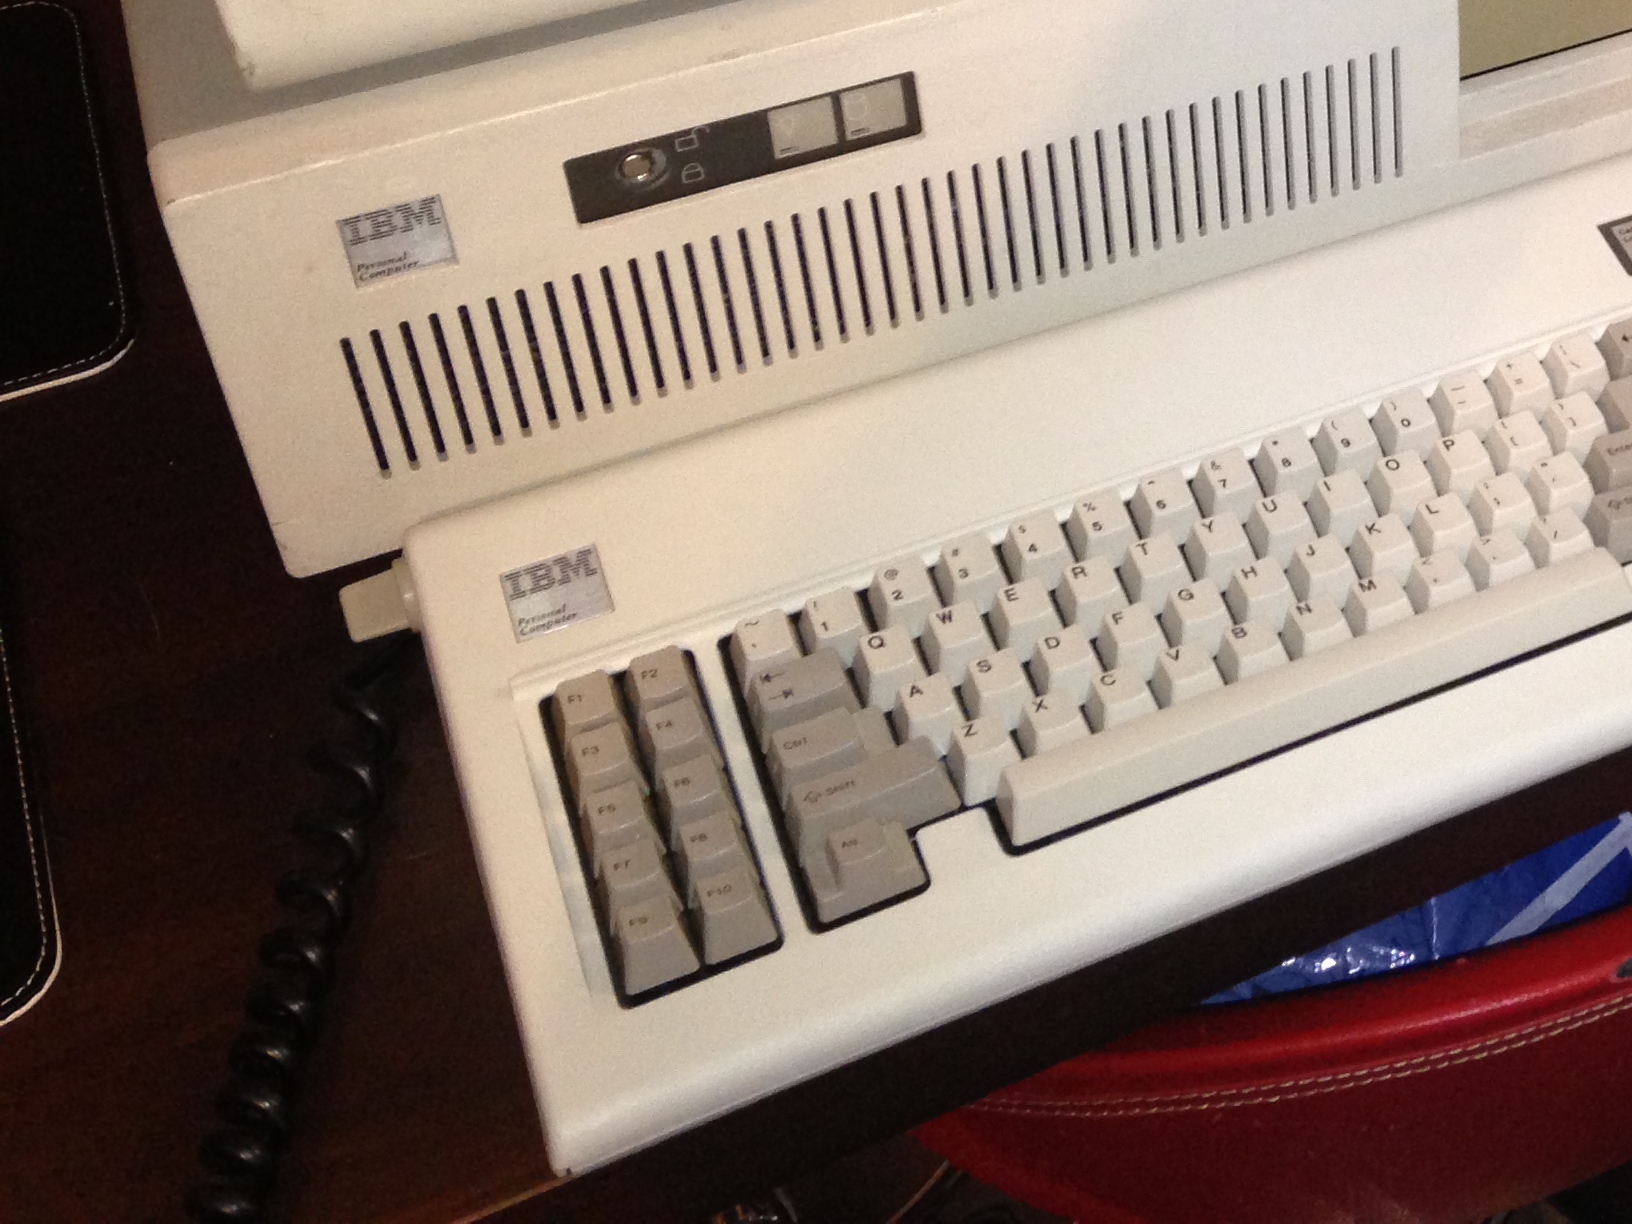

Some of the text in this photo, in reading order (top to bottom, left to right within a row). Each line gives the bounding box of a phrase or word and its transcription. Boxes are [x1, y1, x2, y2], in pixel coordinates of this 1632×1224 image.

[341, 197, 441, 246] IBM
[356, 251, 408, 272] Personal
[359, 261, 420, 281] Computer
[1401, 418, 1411, 427] 0
[1341, 438, 1351, 448] 9
[1442, 438, 1456, 451] P
[1210, 460, 1221, 470] &
[1281, 457, 1292, 467] 8
[1386, 459, 1400, 471] O
[1218, 479, 1228, 488] 7
[1082, 502, 1096, 512] %
[1156, 500, 1167, 509] 6
[1262, 500, 1278, 512] U
[1425, 504, 1439, 514] L
[1092, 521, 1102, 532] 5
[1202, 522, 1217, 533] Y
[1365, 523, 1382, 535] K
[1028, 543, 1038, 554] 4
[1136, 544, 1151, 555] T
[1305, 545, 1316, 557] J
[504, 549, 598, 600] IBM
[884, 568, 899, 580] @
[958, 568, 969, 578] 3
[1072, 567, 1088, 578] R
[1242, 566, 1258, 578] H
[1359, 580, 1377, 592] M
[891, 590, 904, 600] 2
[1004, 588, 1018, 601] E
[1178, 588, 1194, 601] G
[518, 604, 566, 626] Personal
[1296, 604, 1312, 616] N
[936, 611, 954, 624] W
[1112, 612, 1124, 625] F
[520, 612, 578, 636] Computer
[821, 621, 829, 632] 1
[1232, 627, 1247, 638] B
[868, 635, 886, 649] Q
[1045, 637, 1061, 648] D
[1167, 650, 1181, 661] V
[976, 660, 992, 673] S
[641, 668, 658, 680] F2
[1101, 674, 1116, 686] C
[909, 684, 924, 697] A
[567, 694, 583, 705] F1
[1033, 700, 1049, 712] X
[656, 720, 673, 731] F4
[962, 724, 978, 737] Z
[581, 745, 600, 758] F3
[673, 777, 691, 788] F6
[825, 780, 856, 797] Shift
[598, 803, 616, 815] F5
[614, 859, 630, 871] F7
[706, 884, 731, 898] F10
